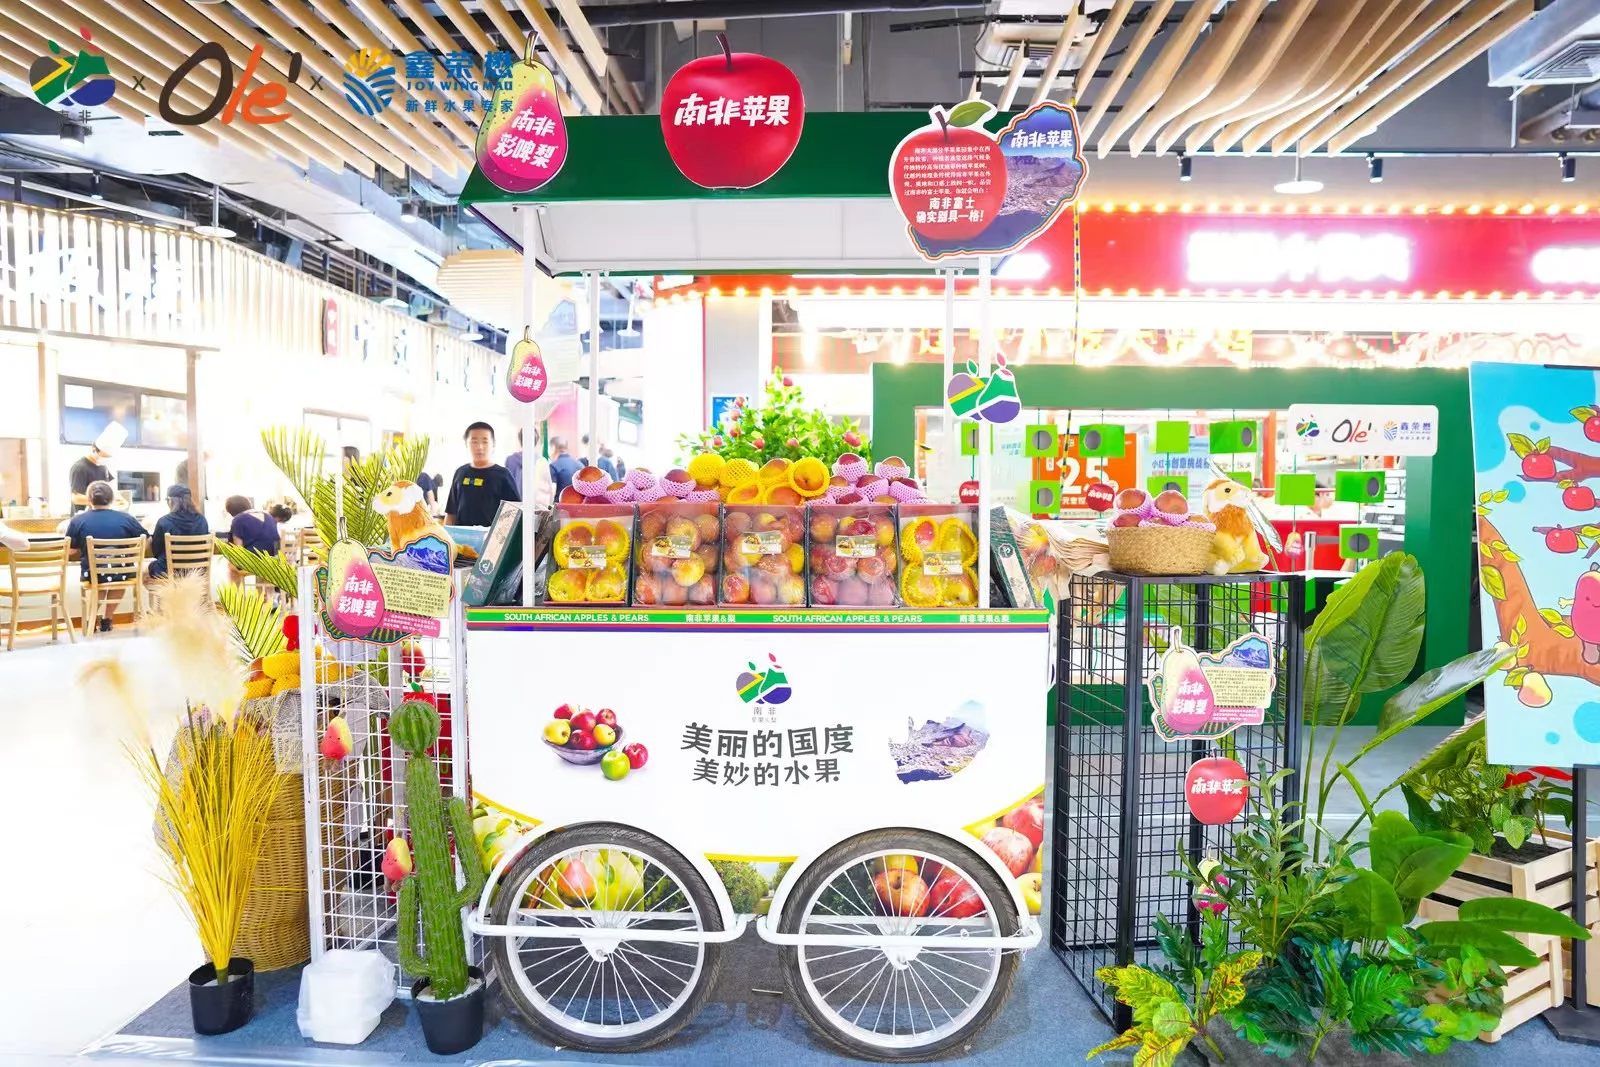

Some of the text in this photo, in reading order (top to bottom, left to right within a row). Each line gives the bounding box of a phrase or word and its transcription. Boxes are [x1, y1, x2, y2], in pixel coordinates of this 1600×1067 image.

[673, 92, 790, 127] 南非苹果
[511, 106, 557, 136] 南非
[1010, 129, 1073, 148] 南非苹果
[492, 132, 559, 169] 彩啤梨
[929, 196, 975, 210] 南非富士
[521, 362, 542, 376] 南非
[514, 376, 543, 392] 彩啤梨
[344, 573, 375, 595] 南非
[337, 596, 379, 618] 彩啤梨
[504, 613, 649, 622] SOUTH AFRICAN APPLES & PEARS
[685, 613, 736, 623] 南非苹果&梨
[773, 614, 923, 623] SOUTH AFRICAN APPLES & PEARS
[959, 614, 1010, 623] 南非苹果&梨
[1178, 678, 1205, 696] 南非
[753, 706, 776, 716] 南非
[1171, 698, 1209, 715] 彩啤梨
[680, 721, 854, 759] 美丽的国度
[692, 756, 841, 787] 美妙的水果
